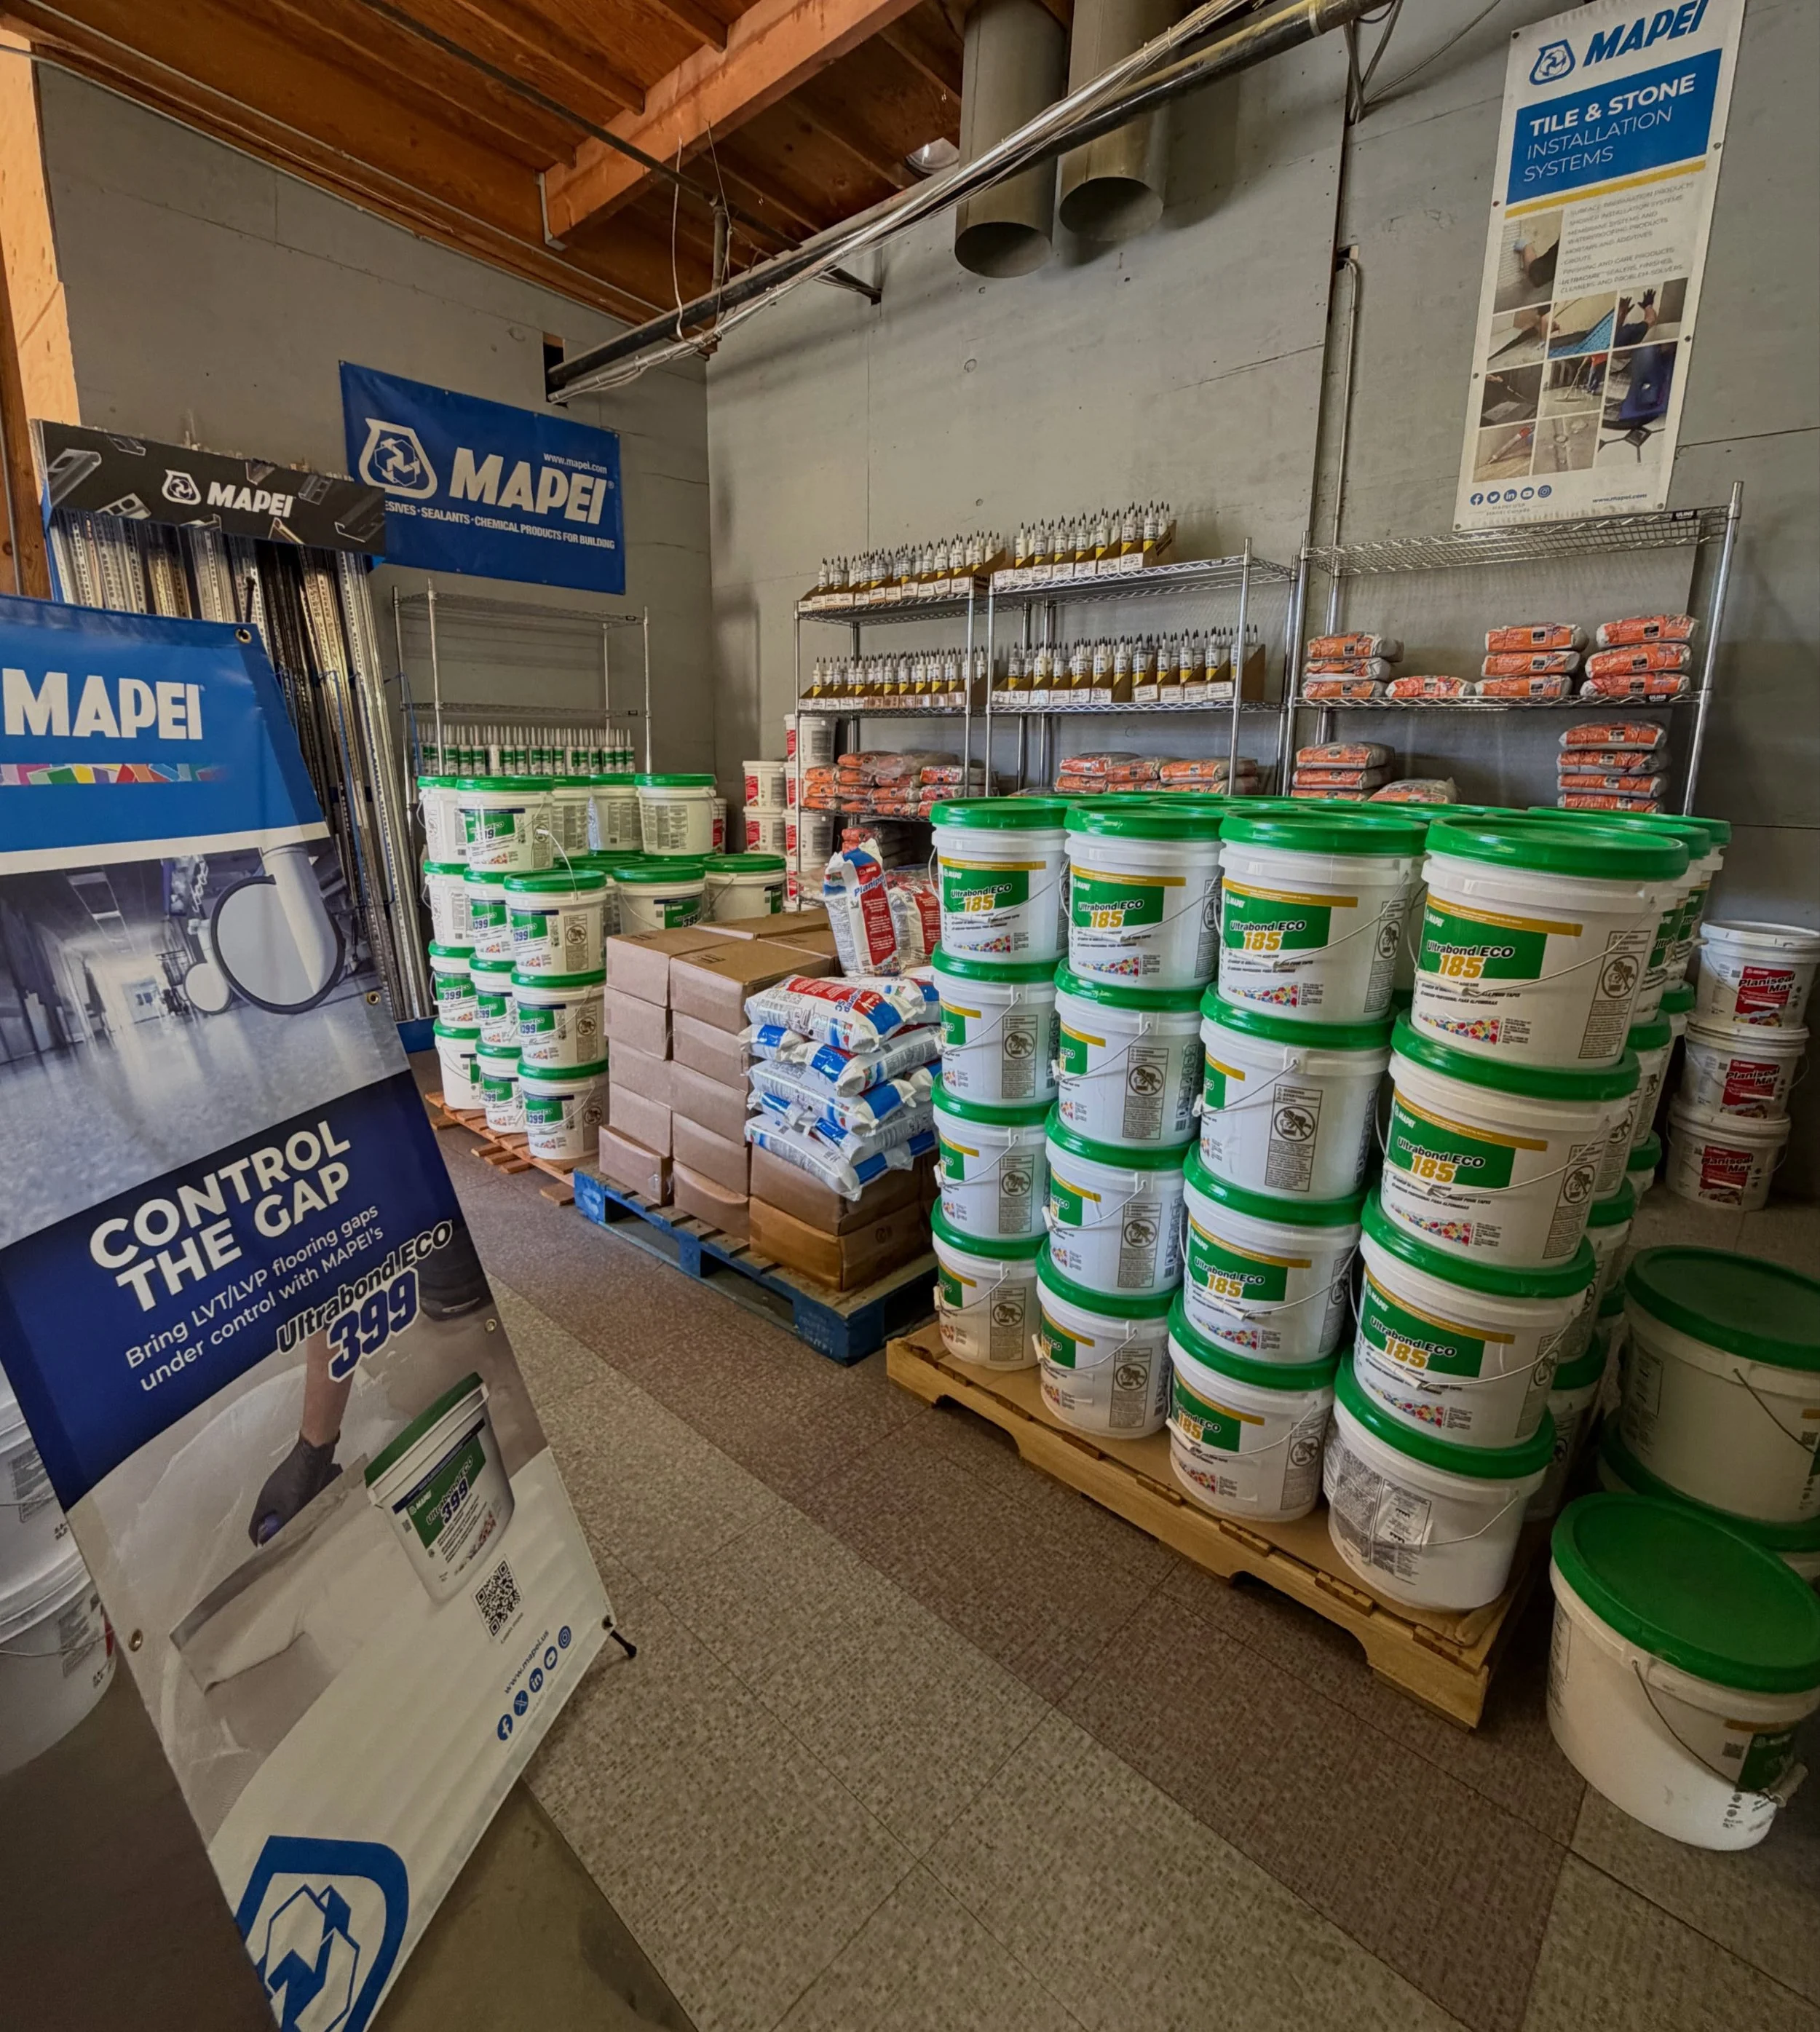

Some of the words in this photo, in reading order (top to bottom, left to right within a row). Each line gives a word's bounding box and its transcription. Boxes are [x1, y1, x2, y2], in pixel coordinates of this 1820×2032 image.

[1583, 0, 1709, 67] MAPEI
[1530, 108, 1580, 137] TILE
[1584, 103, 1602, 122] &
[1608, 73, 1696, 115] STONE
[1527, 106, 1672, 160] INSTALLATION
[1524, 146, 1614, 182] SYSTEMS
[1629, 218, 1668, 231] PRODUCTS
[1642, 210, 1658, 219] AND
[1598, 239, 1615, 249] AND
[1617, 231, 1653, 243] ADDITIVES
[1598, 258, 1613, 267] AND
[1634, 247, 1674, 259] PRODUCTS
[1597, 277, 1613, 286] AND
[543, 452, 607, 474] www.mapei.com
[449, 446, 607, 525] MAPEI
[207, 481, 293, 518] MAPEI
[1592, 493, 1647, 504] www.mapei.com
[421, 507, 470, 525] SEALANTS
[475, 516, 520, 534] CHEMICAL
[521, 524, 562, 541] PRODUCTS
[563, 532, 579, 544] FOR
[579, 535, 615, 550] BUILDING
[2, 668, 203, 740] MAPEI
[951, 887, 989, 898] Ultrabond
[991, 884, 1012, 894] ECO
[965, 894, 995, 912] 185
[1078, 901, 1118, 912] Ultrabond
[1120, 899, 1144, 910] ECO
[1090, 910, 1125, 929] 185
[1230, 920, 1274, 931] Ultrabond
[1278, 920, 1307, 931] ECO
[1429, 914, 1445, 928] MAPEI
[1243, 931, 1284, 952] 185
[1427, 939, 1476, 956] Ultrabond
[1480, 945, 1515, 958] ECO
[1439, 954, 1487, 979] 185
[1738, 973, 1796, 988] Planiseal
[1768, 984, 1793, 993] Max
[1726, 1067, 1780, 1079] Planiseal
[1755, 1078, 1778, 1086] Max
[1398, 1112, 1416, 1128] MAPEI
[1398, 1136, 1449, 1163] Ultrabond
[1452, 1154, 1485, 1168] ECO
[1701, 1154, 1754, 1164] Planiseal
[1411, 1155, 1457, 1185] 185
[90, 1120, 351, 1268] CONTROL
[115, 1218, 242, 1312] THE
[254, 1162, 349, 1238] GAP
[1194, 1256, 1238, 1281] Ultrabond
[1239, 1273, 1265, 1285] ECO
[125, 1320, 189, 1369] Bring
[191, 1269, 268, 1327] LVT/LVP
[272, 1230, 338, 1276] flooring
[341, 1206, 379, 1238] gaps
[277, 1252, 395, 1355] Ultrabond
[400, 1221, 453, 1270] ECO
[1207, 1273, 1245, 1298] 185
[141, 1341, 204, 1391] under
[210, 1296, 277, 1345] control
[279, 1268, 319, 1300] with
[321, 1227, 384, 1273] MAPEI's
[1372, 1291, 1390, 1312] MAPEI
[327, 1267, 420, 1383] 399
[1370, 1316, 1422, 1349] Ultrabond
[1425, 1343, 1456, 1358] ECO
[1385, 1337, 1431, 1369] 185
[1178, 1411, 1204, 1442] 185
[1200, 1418, 1221, 1433] ECO
[441, 1476, 469, 1526] 399
[505, 1629, 549, 1694] www.mapei.us
